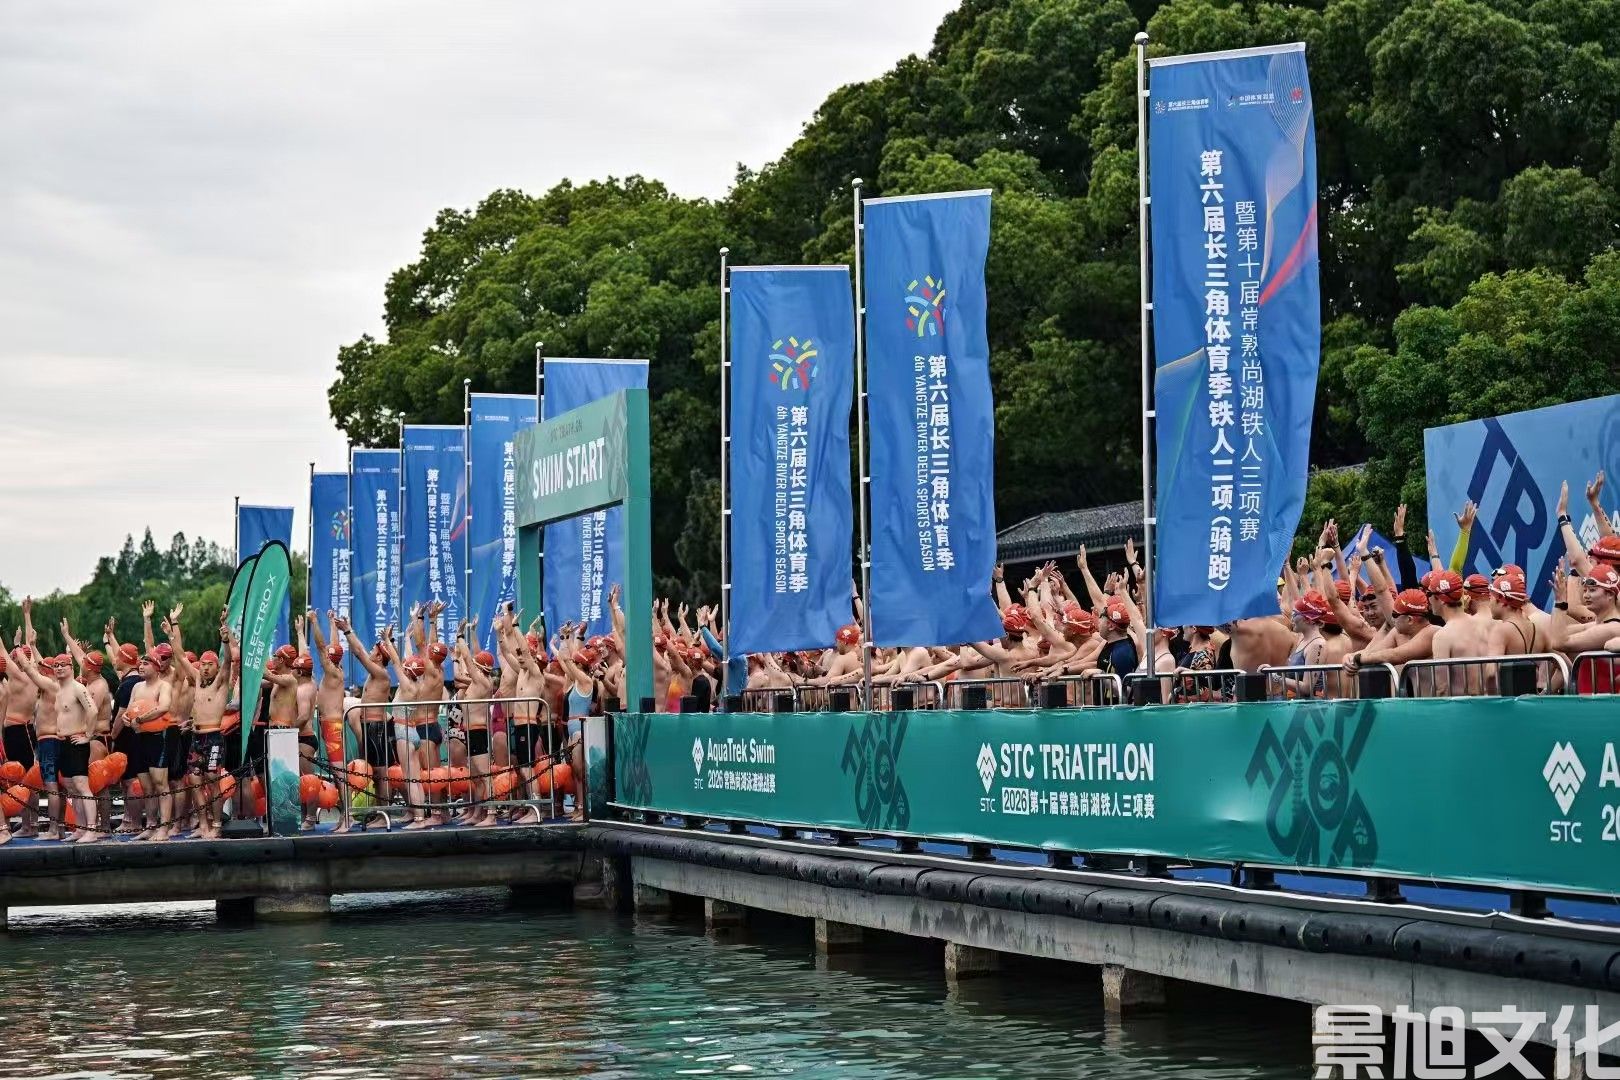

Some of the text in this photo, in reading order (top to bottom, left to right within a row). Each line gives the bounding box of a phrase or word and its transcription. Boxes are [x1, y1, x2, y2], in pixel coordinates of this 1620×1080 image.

[1235, 200, 1265, 542] 暨第十届常熟尚湖铁人三项赛
[532, 437, 605, 499] SWIM START
[914, 355, 936, 571] 6th YANGTZE RIVER DELTA SPORTS SEASON
[928, 354, 955, 571] 第六届长三角体育季
[775, 406, 789, 593] 6th YANGTZE RIVER DELTA SPORTS SEASON
[787, 405, 809, 593] 第六届长三角体育季
[581, 516, 592, 622] RIVER DELTA SPORTS SEASON
[707, 737, 775, 768] AquaTrek Swim
[1000, 742, 1154, 781] STC TRIATHLON
[694, 778, 704, 790] STC
[707, 769, 724, 789] 2026
[1003, 788, 1155, 819] 2026 第十届常熟尚湖铁人三项赛
[980, 797, 996, 813] STC
[1550, 820, 1583, 843] STC
